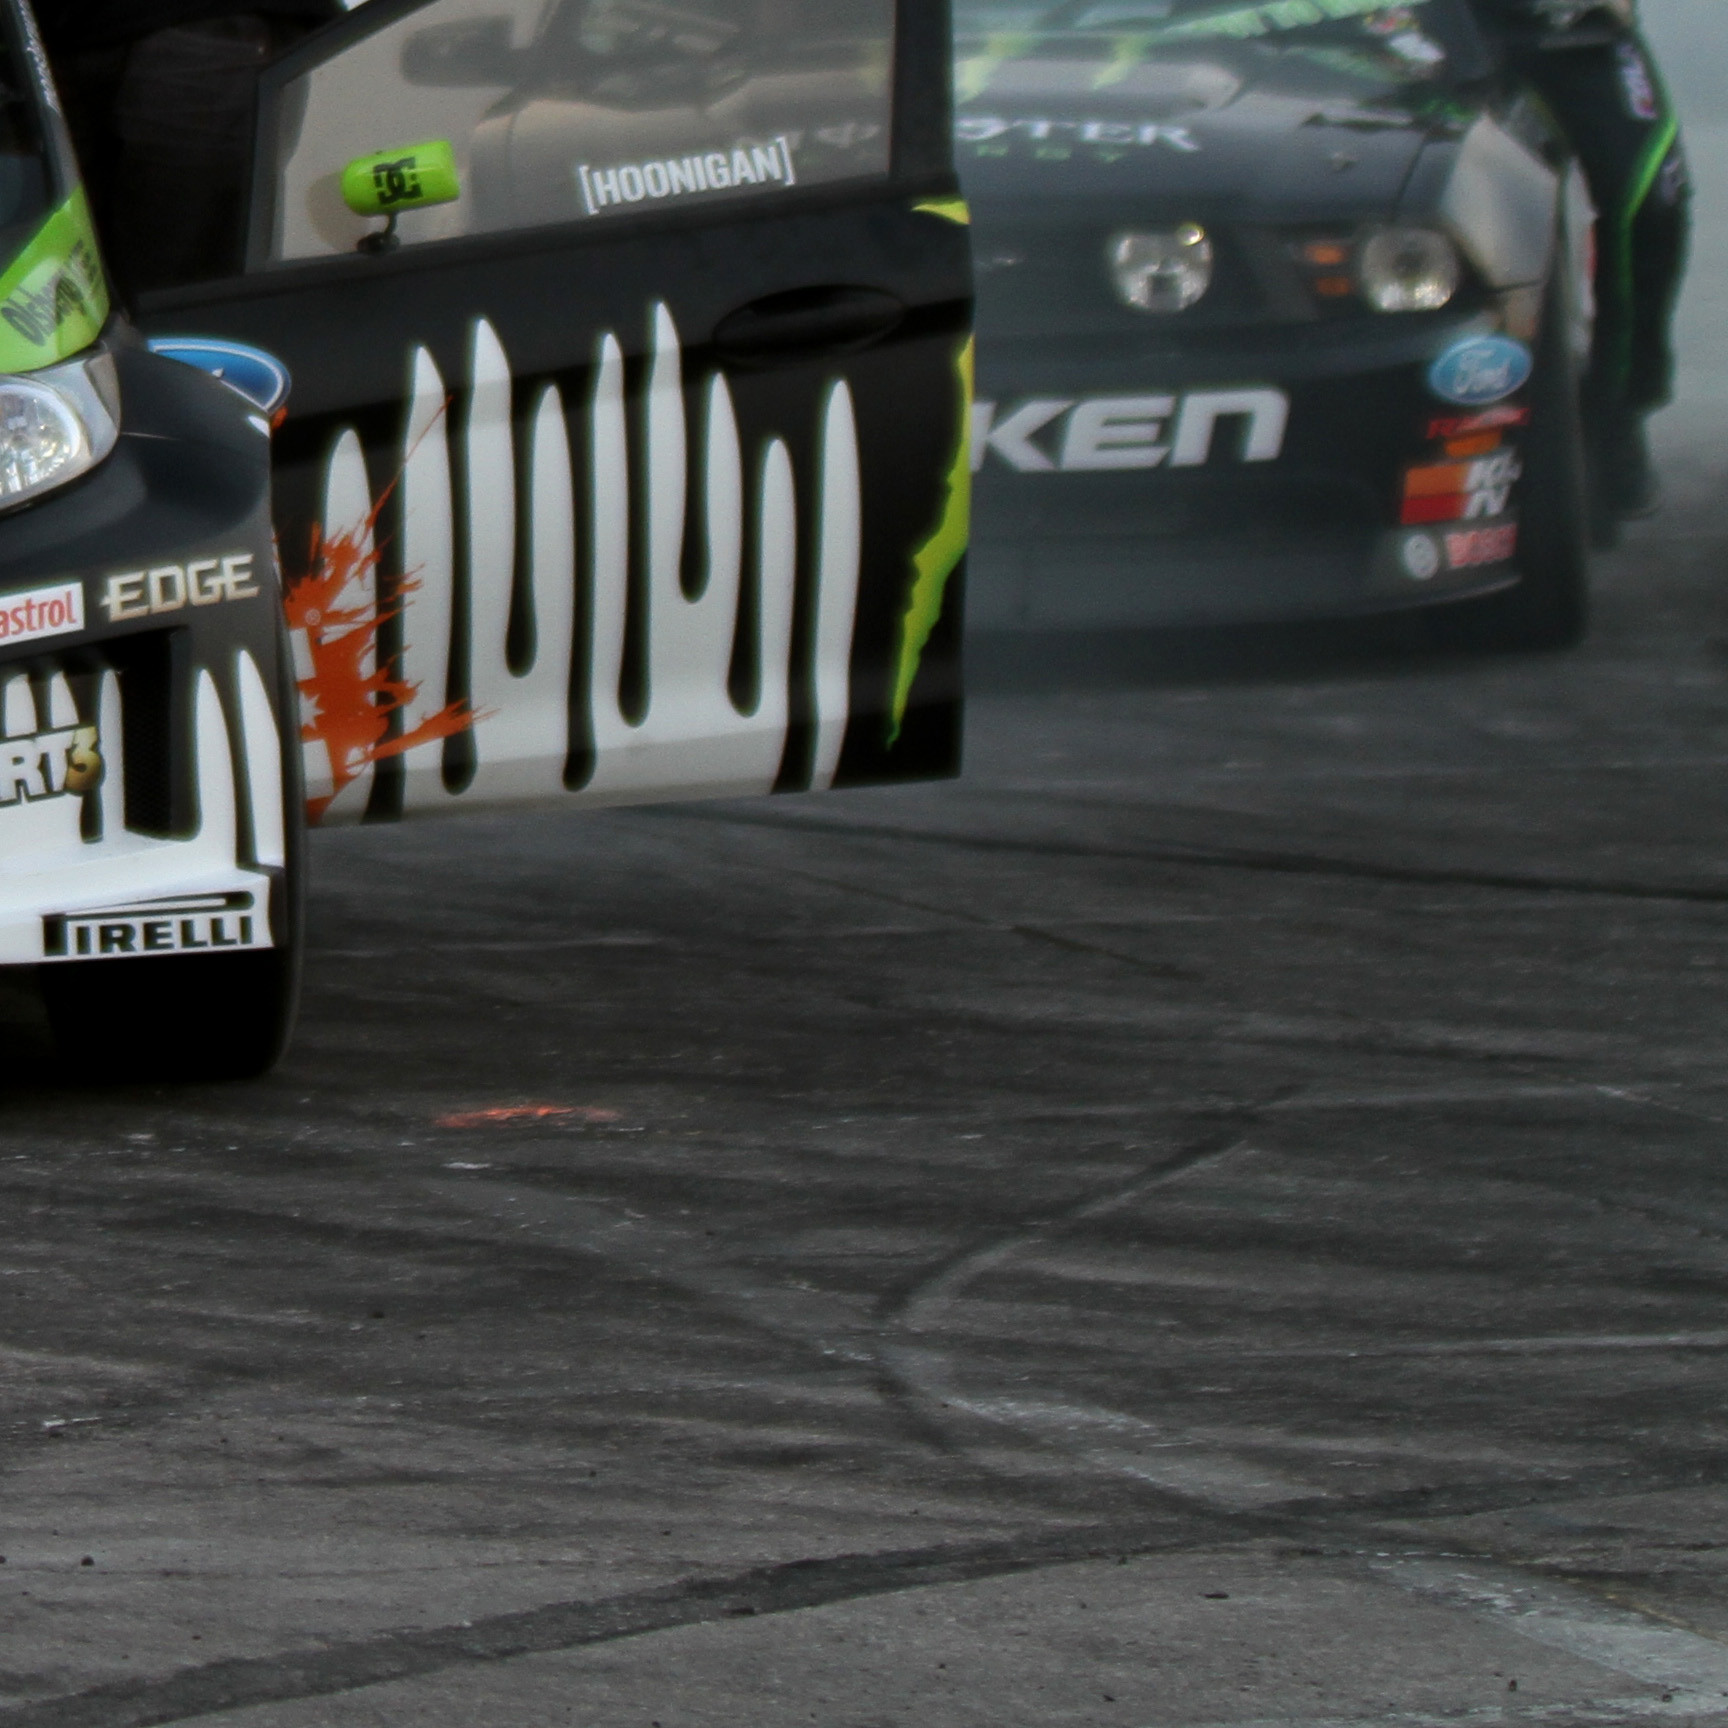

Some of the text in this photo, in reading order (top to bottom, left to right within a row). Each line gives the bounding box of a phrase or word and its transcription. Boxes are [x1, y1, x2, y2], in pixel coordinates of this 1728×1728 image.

[970, 386, 1292, 473] KEN
[100, 553, 260, 622] EDGE
[42, 889, 254, 956] PIRELLI
